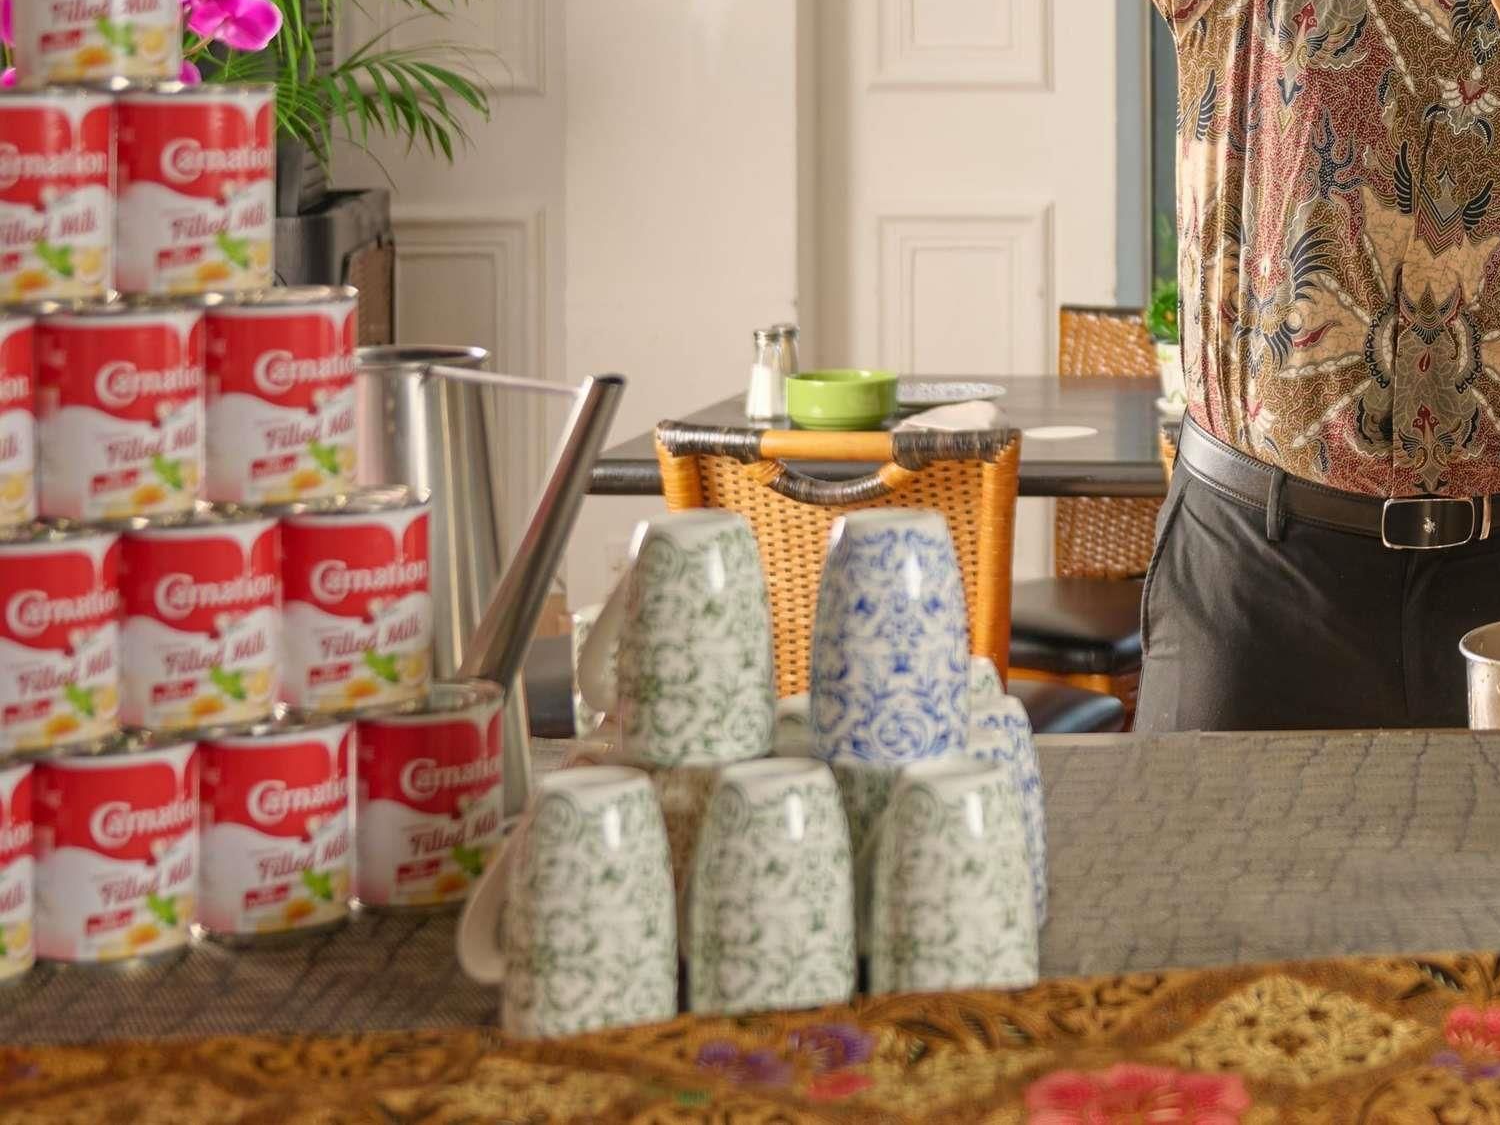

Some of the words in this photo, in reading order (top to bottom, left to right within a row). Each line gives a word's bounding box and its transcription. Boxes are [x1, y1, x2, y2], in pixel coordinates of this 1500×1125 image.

[0, 219, 48, 246] illed
[94, 360, 201, 409] Carnatio
[153, 571, 275, 621] Carnation
[309, 558, 428, 605] Carnation
[5, 588, 121, 639] Carnatio
[246, 776, 348, 825] Carnatio
[401, 756, 502, 802] Carnatio
[89, 798, 195, 850] Carnatio
[408, 823, 470, 856] Filled
